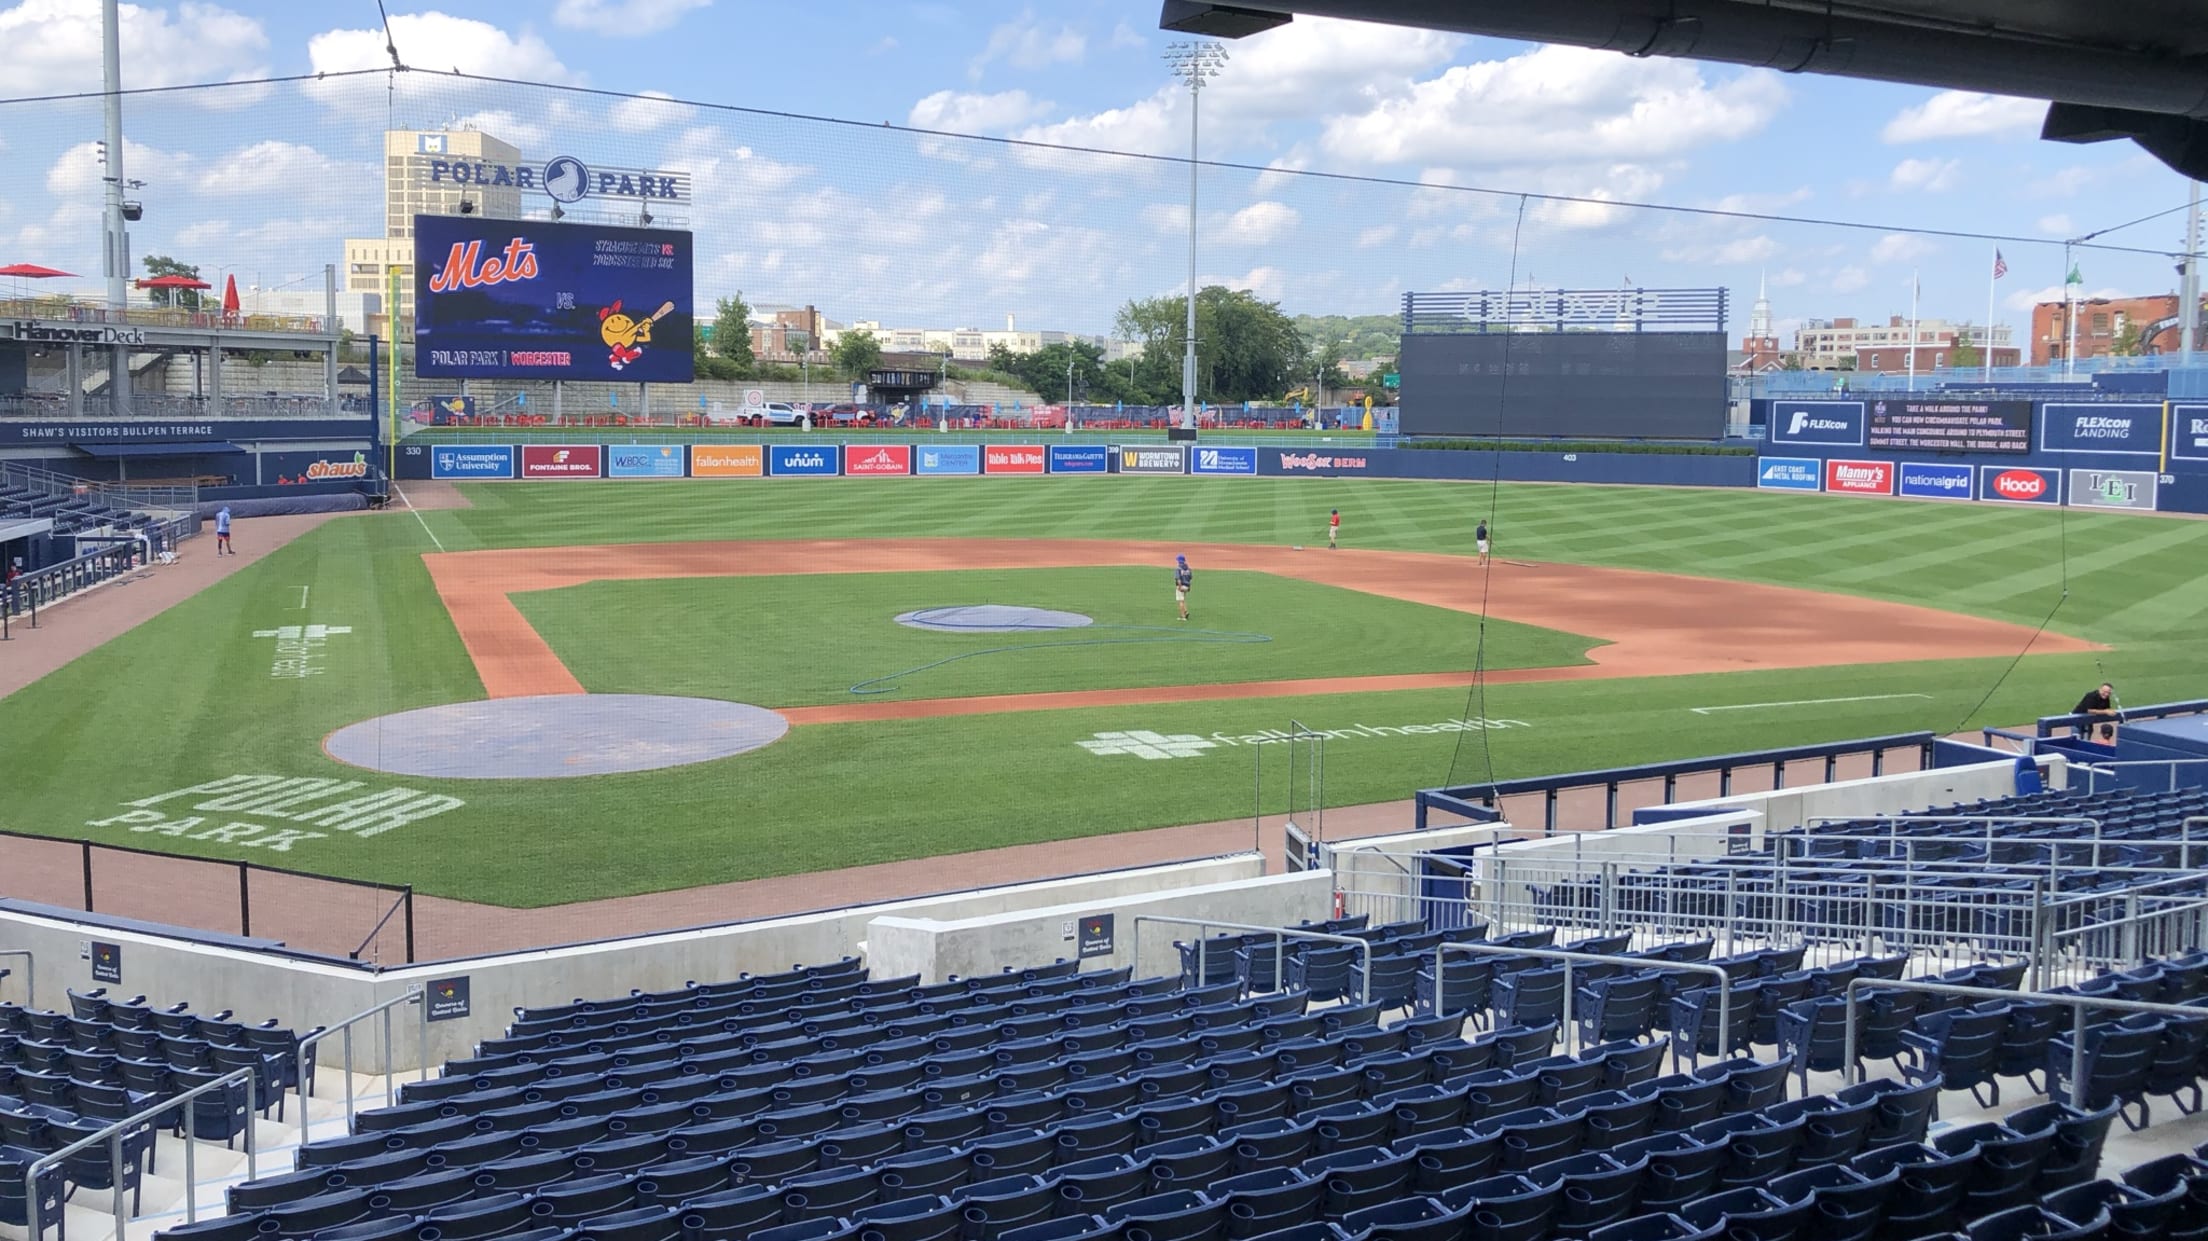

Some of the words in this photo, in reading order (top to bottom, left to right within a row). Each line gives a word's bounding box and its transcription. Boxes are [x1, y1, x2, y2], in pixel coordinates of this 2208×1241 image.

[431, 159, 534, 188] POLAR
[599, 173, 678, 198] PARK
[429, 237, 540, 292] Mets
[14, 321, 103, 341] Hanover
[103, 327, 143, 344] Deck
[431, 350, 468, 366] POLAR
[470, 351, 499, 366] PARK
[510, 351, 572, 367] WORCESTER
[22, 428, 64, 437] SHAW'S
[68, 427, 120, 437] VISITORS
[122, 426, 167, 436] BULLPEN
[170, 426, 212, 435] TERRACE
[2074, 428, 2130, 439] LANDING
[406, 446, 422, 456] 330
[456, 453, 508, 462] Assumption
[1139, 452, 1180, 460] WORMTOWN
[696, 456, 759, 467] fallonhealth
[988, 453, 1008, 464] Table
[1025, 454, 1042, 464] Pies
[1280, 453, 1332, 470] WooSox
[1334, 458, 1366, 468] BERM
[1563, 454, 1577, 462] 403
[456, 462, 500, 471] University
[1836, 465, 1884, 480] Manny's
[1842, 481, 1876, 489] APPLIANCE
[1905, 474, 1968, 489] nationalgrid
[2000, 477, 2040, 492] Hood
[119, 774, 466, 839] POLAR
[85, 808, 328, 852] PARK
